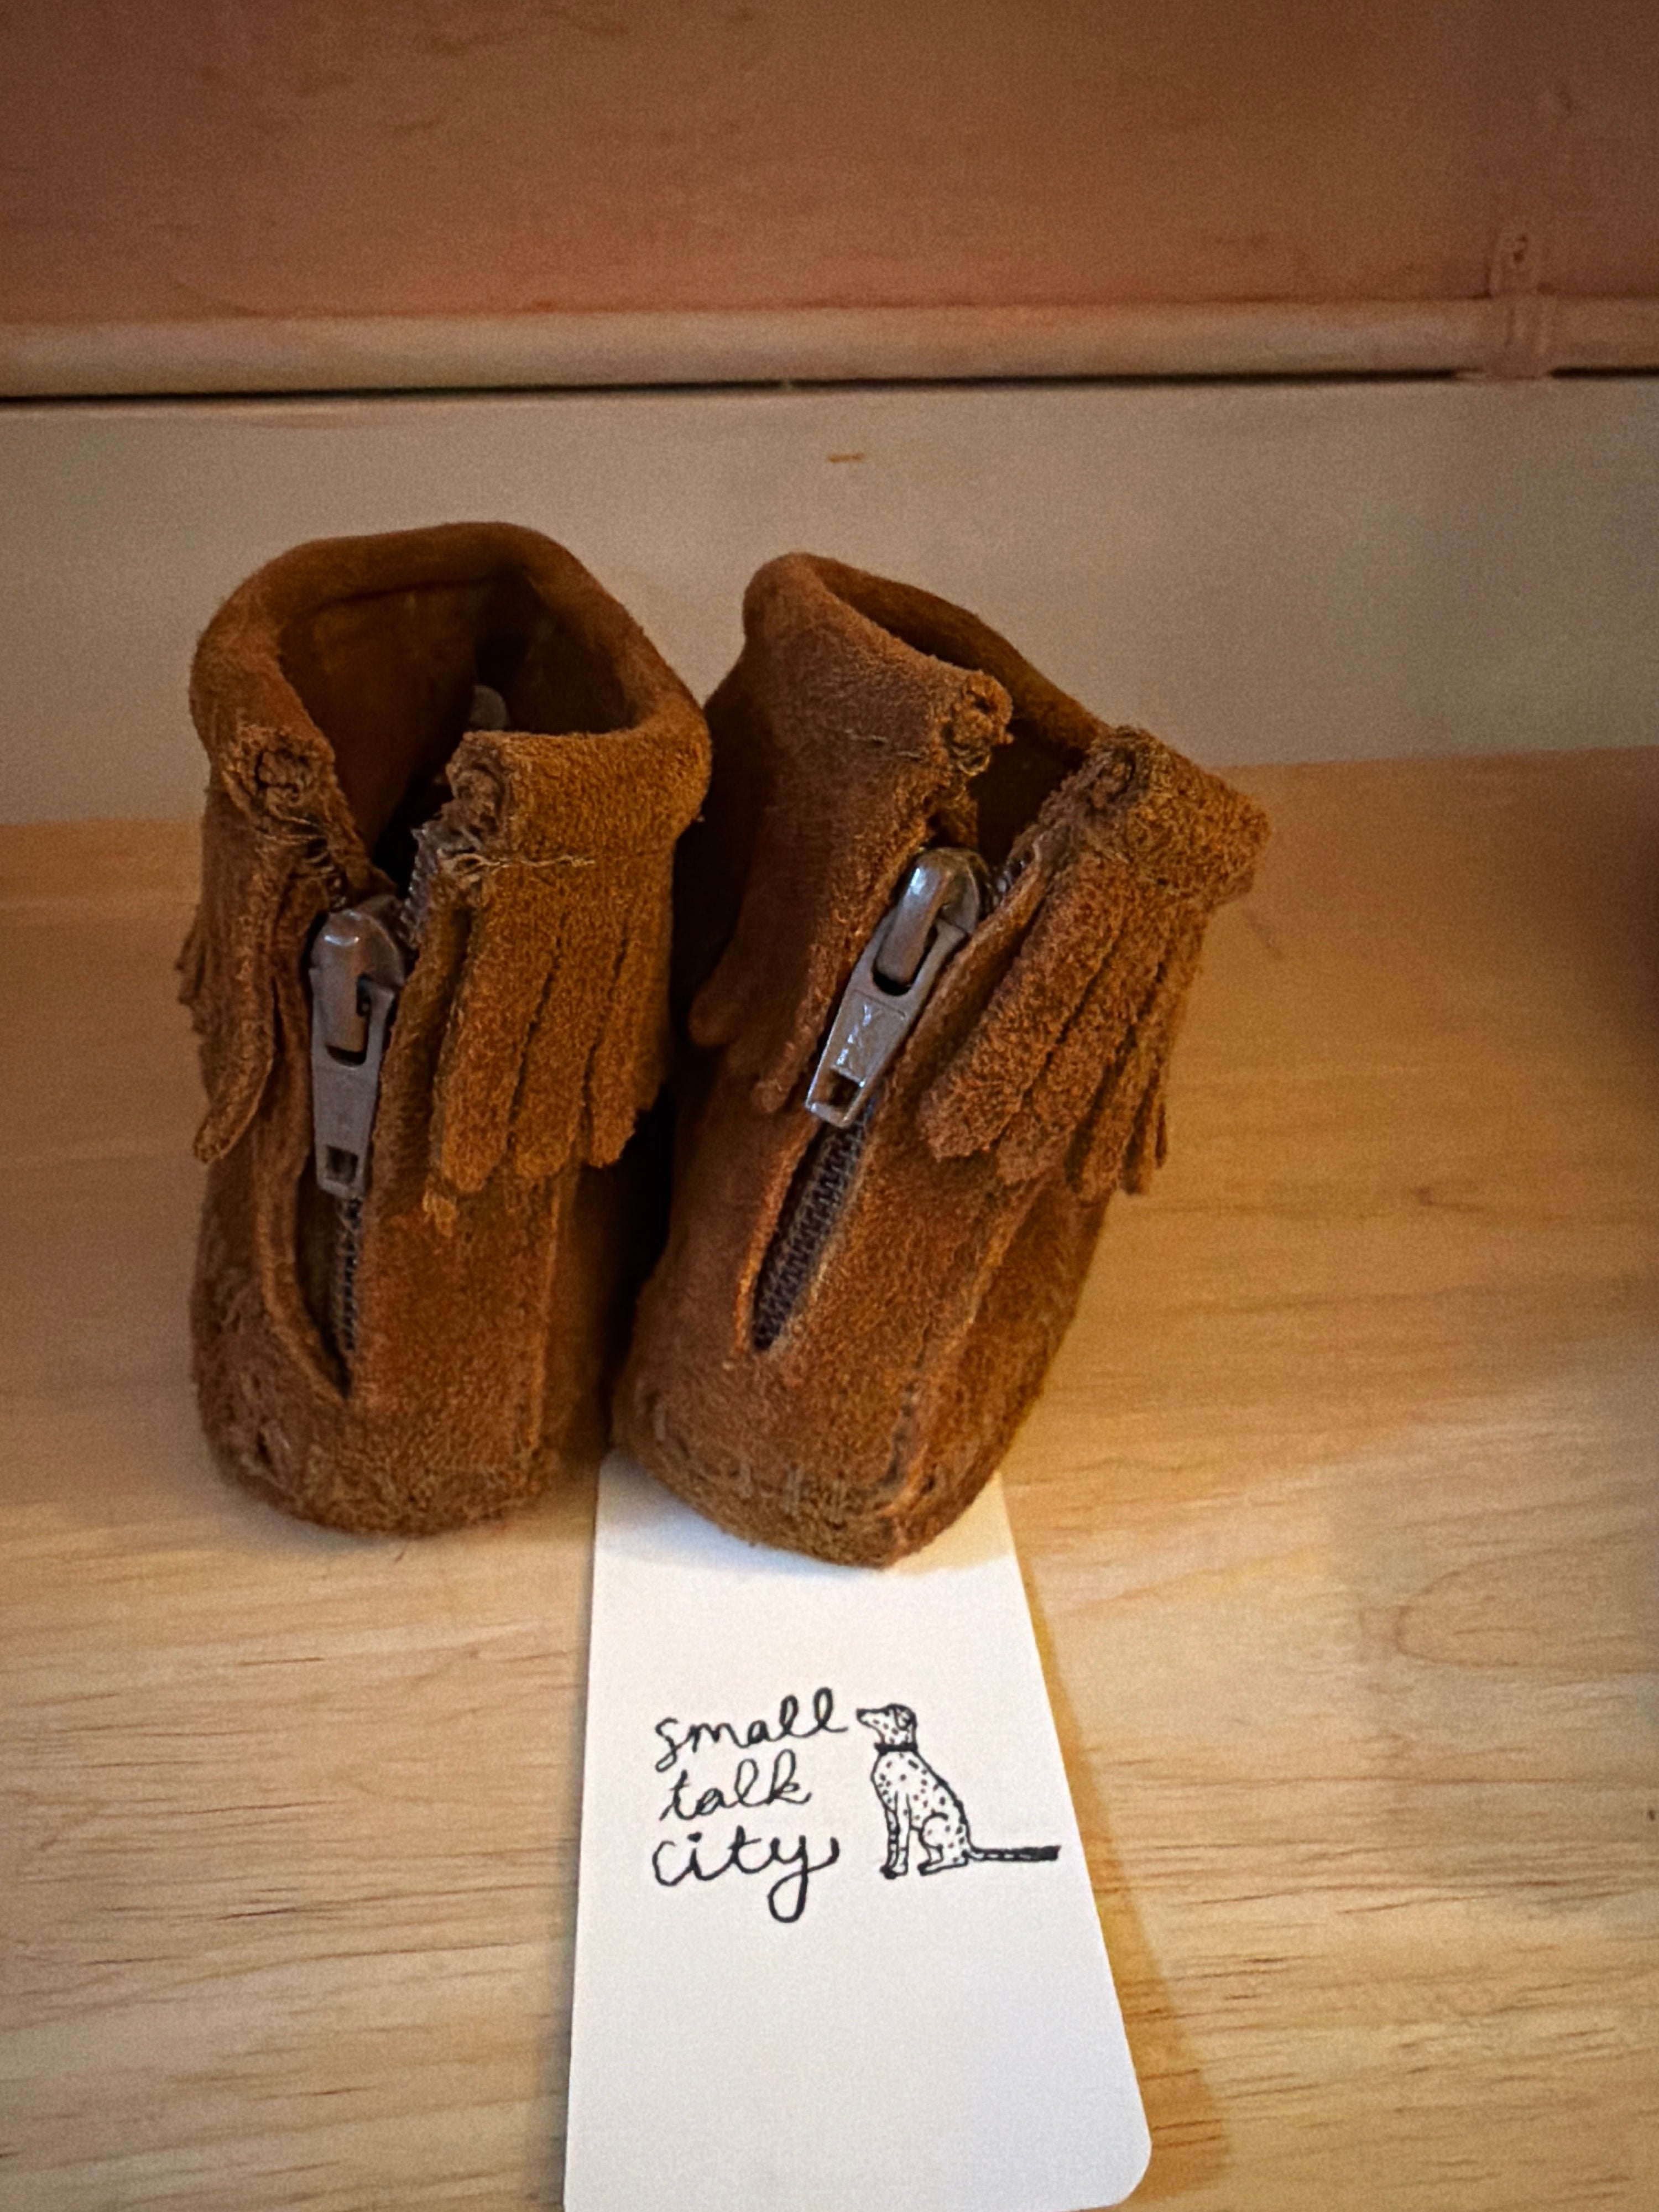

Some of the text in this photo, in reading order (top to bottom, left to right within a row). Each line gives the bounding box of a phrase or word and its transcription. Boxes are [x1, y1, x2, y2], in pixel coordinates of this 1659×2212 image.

[655, 1687, 847, 1772] small
[660, 1749, 811, 1820] talk
[652, 1826, 839, 1923] city
